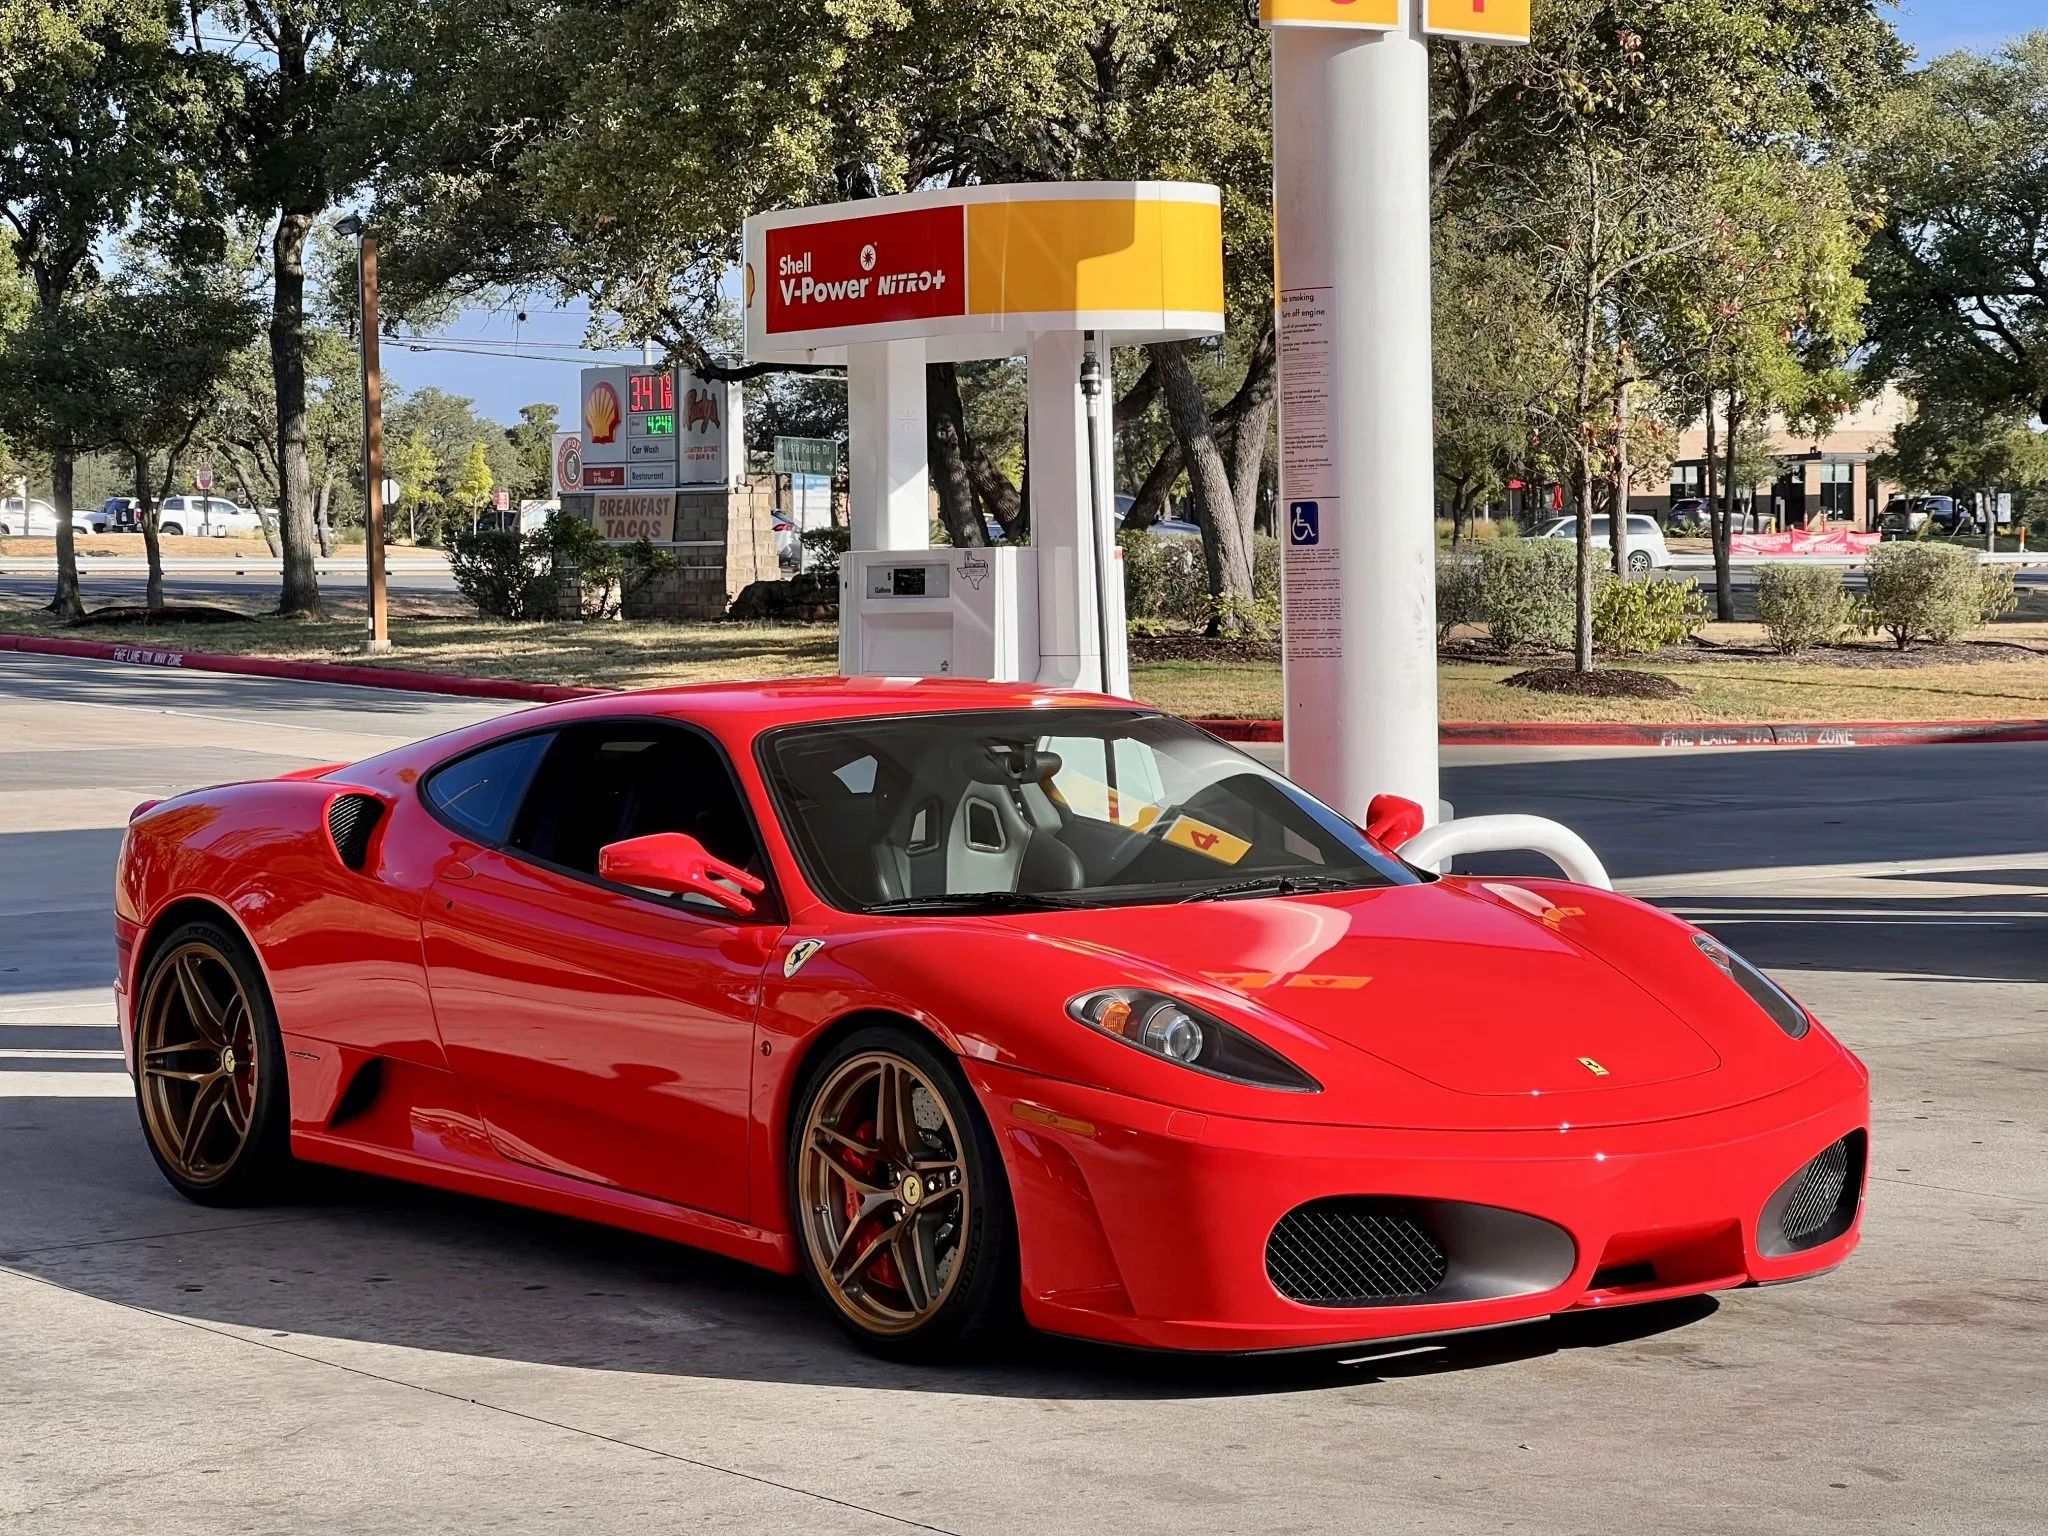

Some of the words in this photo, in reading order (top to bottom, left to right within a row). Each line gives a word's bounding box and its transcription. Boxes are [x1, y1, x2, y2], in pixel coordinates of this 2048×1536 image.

[779, 252, 811, 276] Shell
[779, 276, 870, 306] V-Power
[1288, 293, 1315, 303] smoking
[1291, 309, 1301, 318] off
[1301, 308, 1326, 318] engine
[559, 440, 582, 463] CHIPOT
[631, 446, 642, 454] Car
[643, 444, 660, 454] Wash
[785, 441, 800, 453] Vista
[801, 443, 821, 455] Parke
[822, 444, 831, 455] Dr
[777, 456, 811, 471] immerman
[813, 460, 821, 471] Ln
[632, 471, 664, 480] Restaurant
[599, 496, 670, 517] BREAKFAST
[606, 520, 662, 539] TACOS
[1792, 543, 1813, 552] NOW
[1814, 542, 1848, 552] HIRING
[1817, 728, 1856, 745] ZONE
